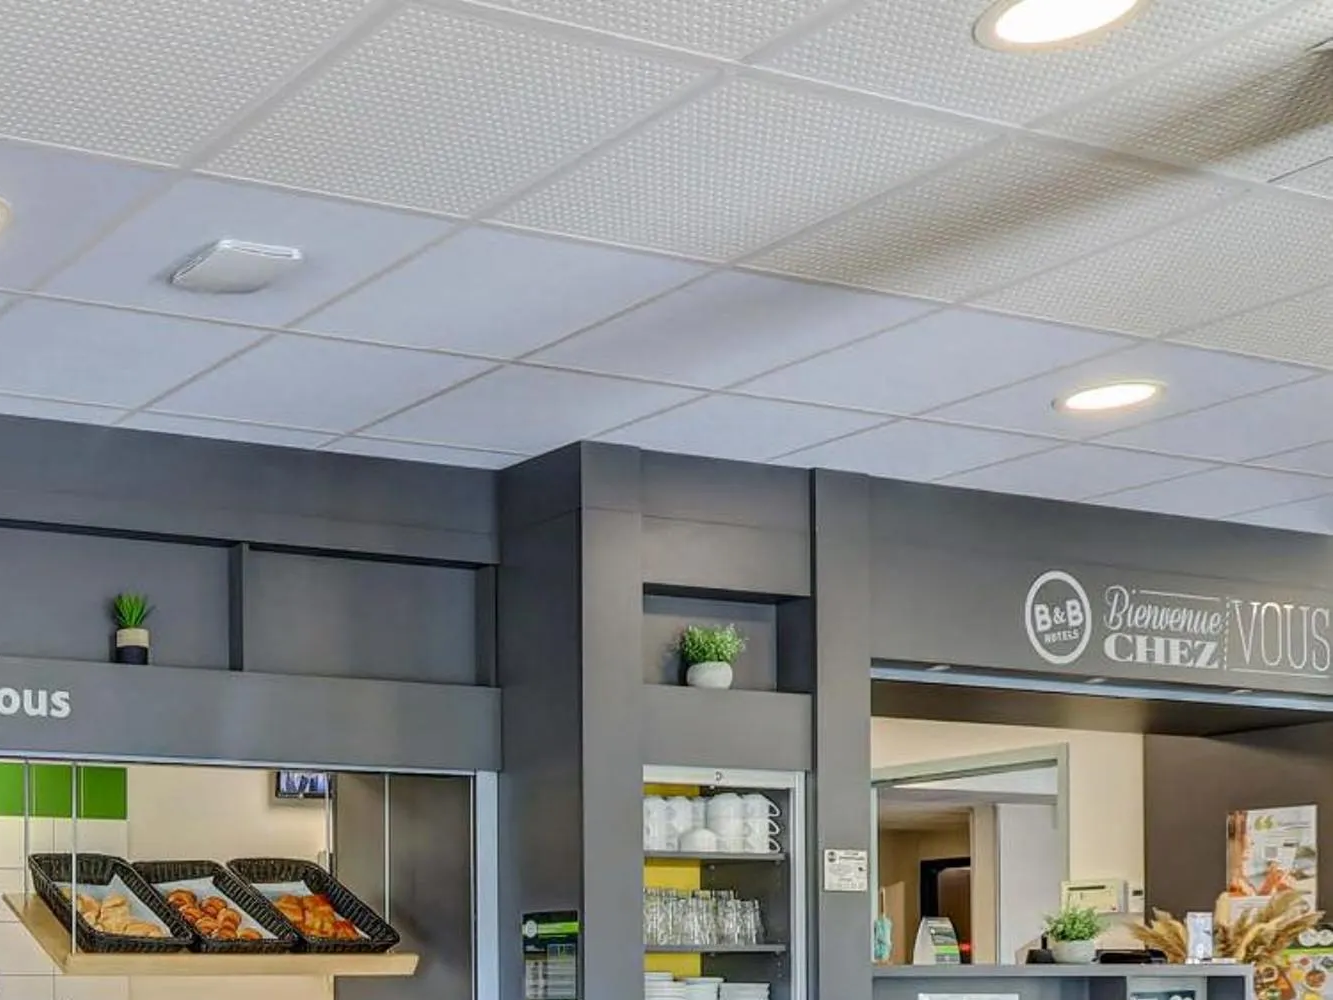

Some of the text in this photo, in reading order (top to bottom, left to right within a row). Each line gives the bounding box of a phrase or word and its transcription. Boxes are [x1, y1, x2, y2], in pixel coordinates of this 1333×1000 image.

[1033, 599, 1084, 633] B&B
[1103, 585, 1224, 634] Bienvenue
[1044, 629, 1080, 644] HOTELS
[1103, 632, 1219, 670] CHEZ
[1231, 600, 1332, 672] VOUS
